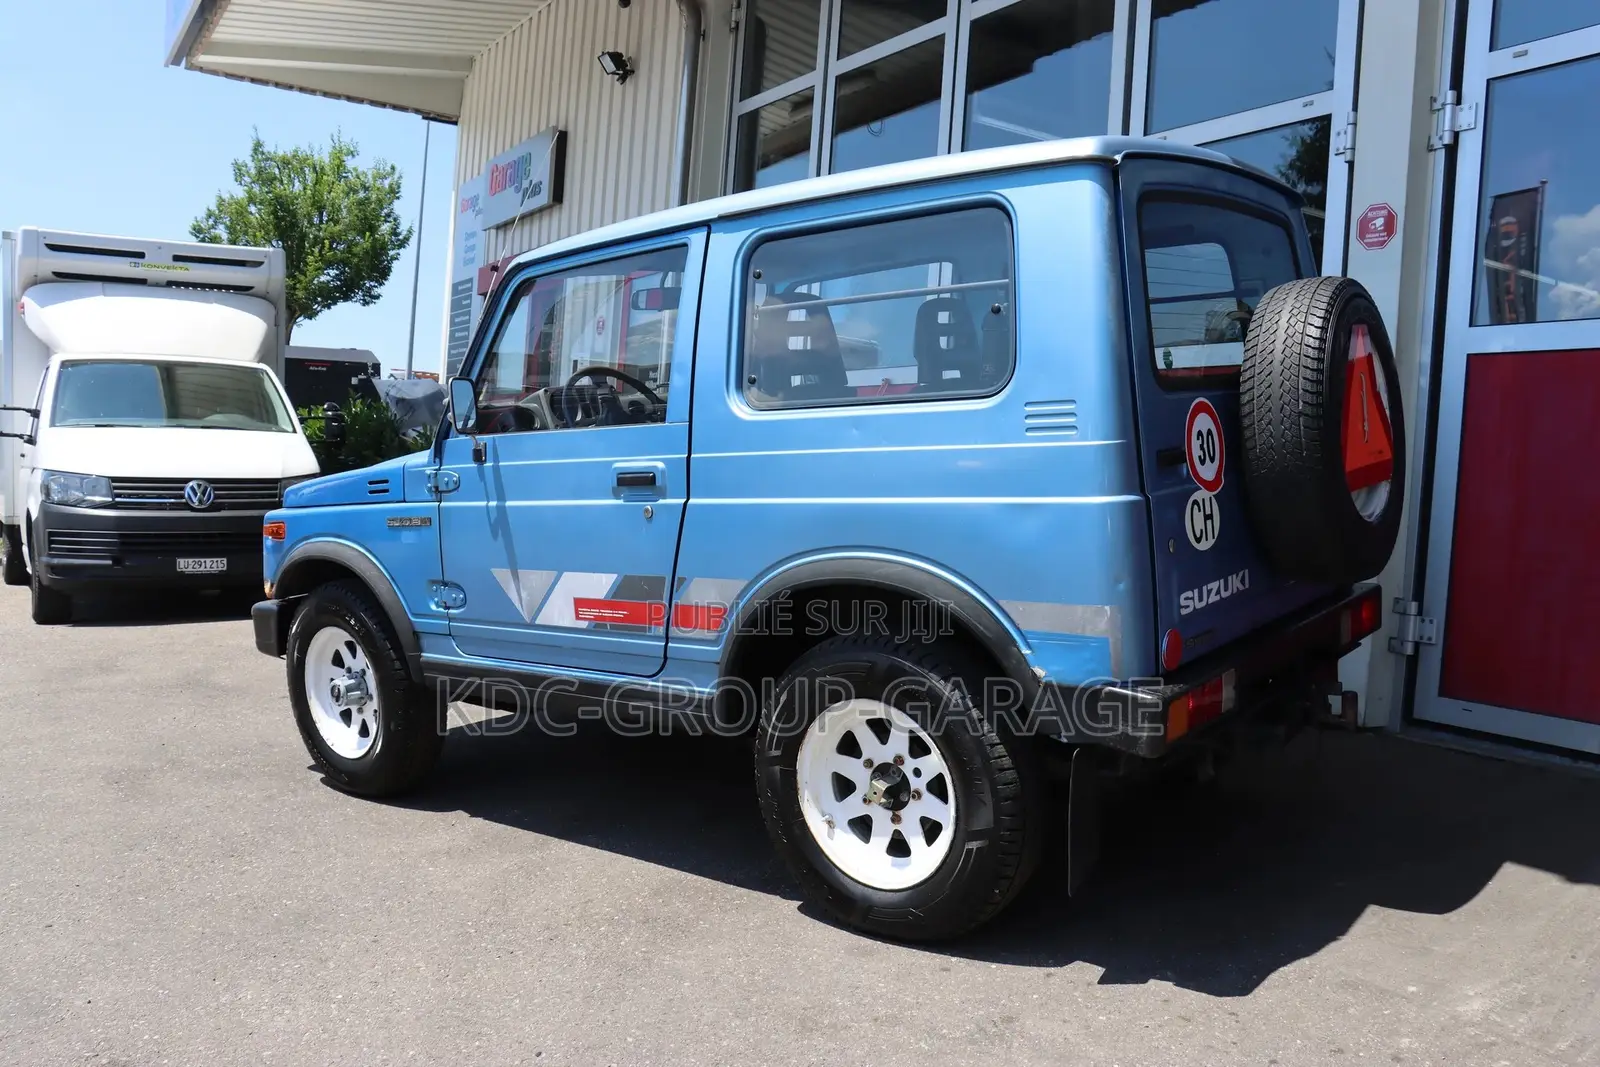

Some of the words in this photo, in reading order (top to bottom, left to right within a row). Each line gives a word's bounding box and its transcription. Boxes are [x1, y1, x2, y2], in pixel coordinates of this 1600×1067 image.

[489, 152, 531, 196] Garage
[520, 179, 543, 207] plus
[1196, 429, 1216, 467] 30
[1190, 496, 1215, 544] CH
[1179, 569, 1250, 616] SUZUKI
